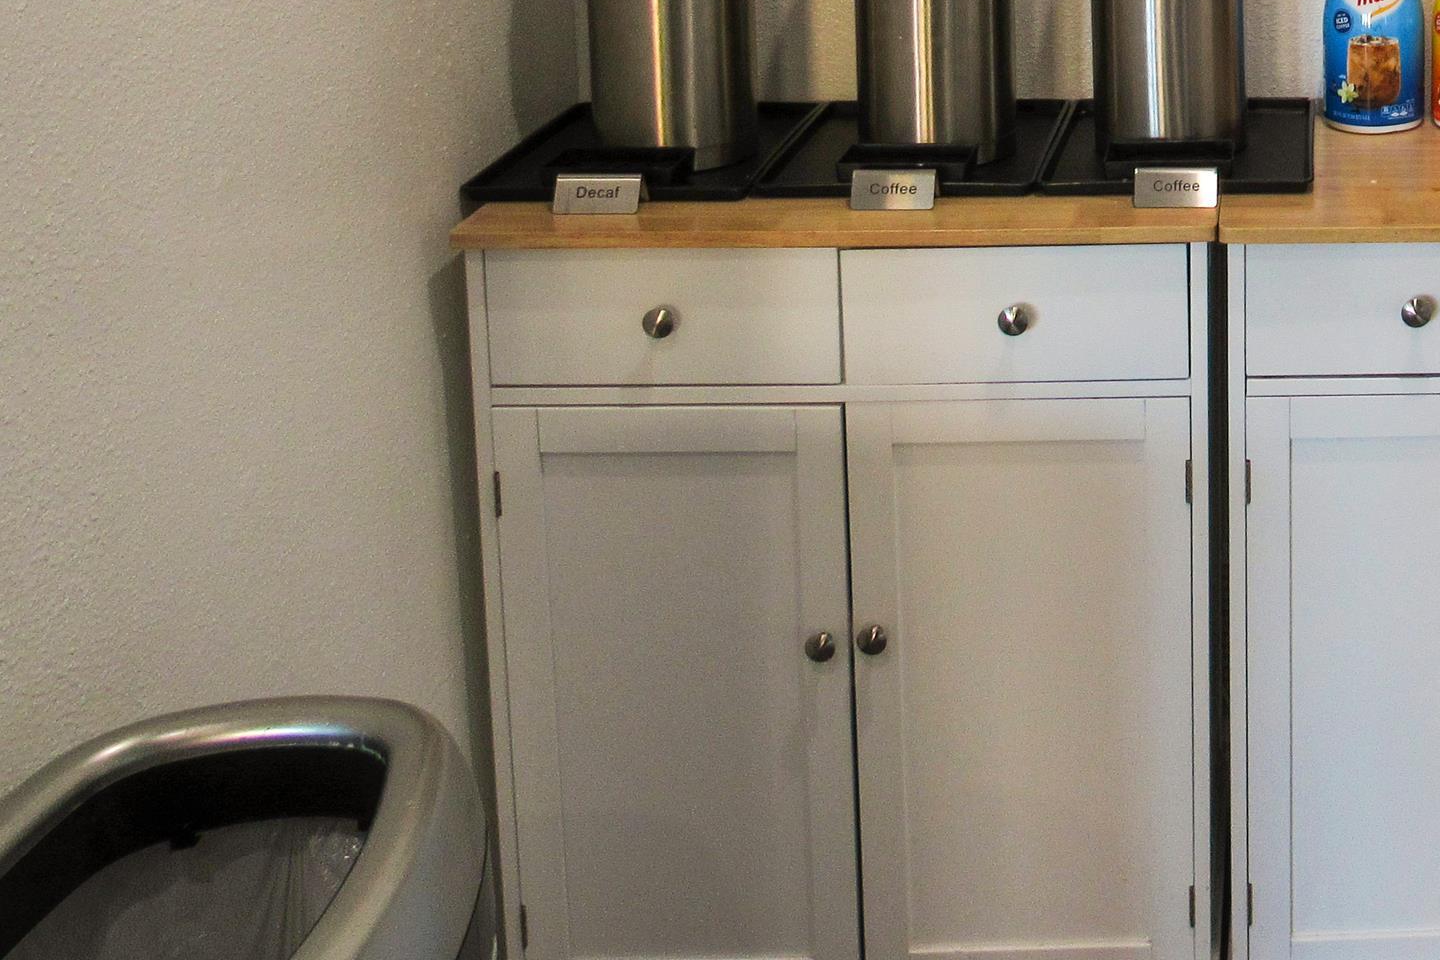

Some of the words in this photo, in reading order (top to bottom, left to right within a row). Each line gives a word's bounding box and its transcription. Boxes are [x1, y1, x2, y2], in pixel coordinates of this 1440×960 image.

[869, 183, 918, 195] Coffee
[1153, 179, 1200, 192] Coffee
[576, 186, 621, 199] Decaf
